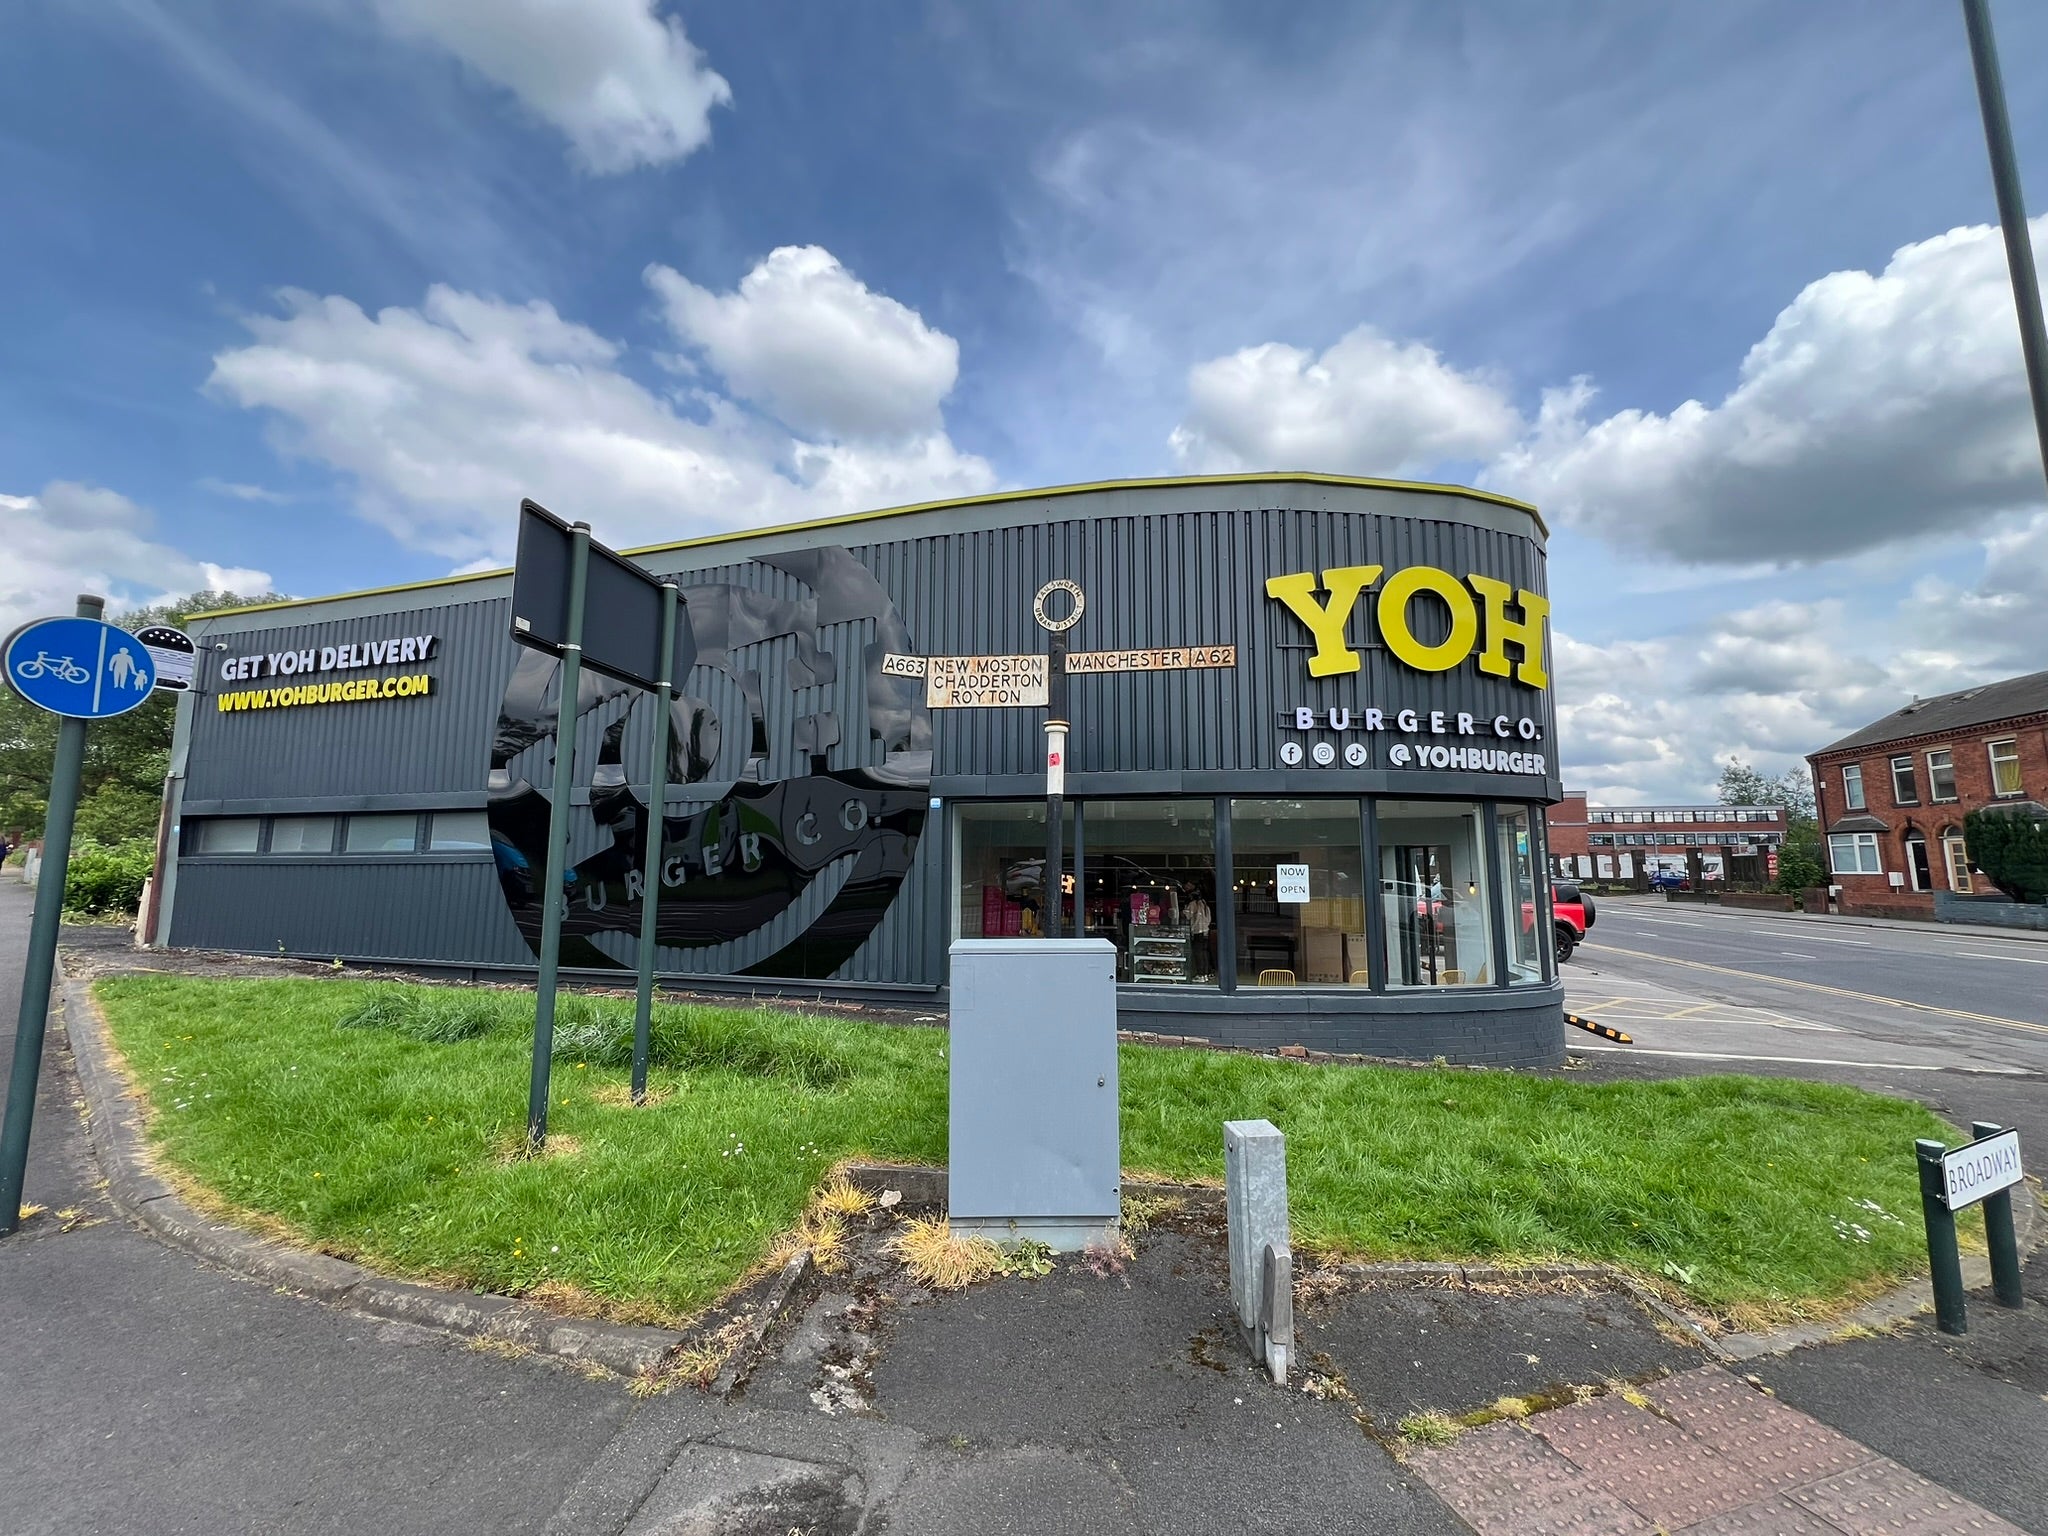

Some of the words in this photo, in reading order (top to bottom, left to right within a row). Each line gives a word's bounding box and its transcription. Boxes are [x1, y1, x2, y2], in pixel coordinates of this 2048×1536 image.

[1035, 607, 1052, 628] URBAN
[1056, 605, 1083, 629] DISTRICT
[1265, 565, 1550, 690] YOH
[221, 655, 264, 680] GET
[266, 649, 315, 676] YOH
[320, 635, 433, 671] DELIVERY
[884, 657, 925, 674] A663
[934, 660, 970, 673] NEW
[976, 658, 1042, 673] MOSTON
[1069, 652, 1183, 670] MANCHESTER
[934, 674, 1043, 689] CHADDERTON
[218, 674, 429, 712] WWW.YOHBURGER.COM
[951, 690, 1021, 704] ROYTON
[1296, 707, 1475, 735] BURGER
[1494, 715, 1541, 740] CO.
[1389, 744, 1547, 775] @YOHBURGER
[1280, 867, 1306, 876] NOW
[1280, 885, 1306, 894] OPEN
[1948, 1144, 2018, 1195] BROADWAY
